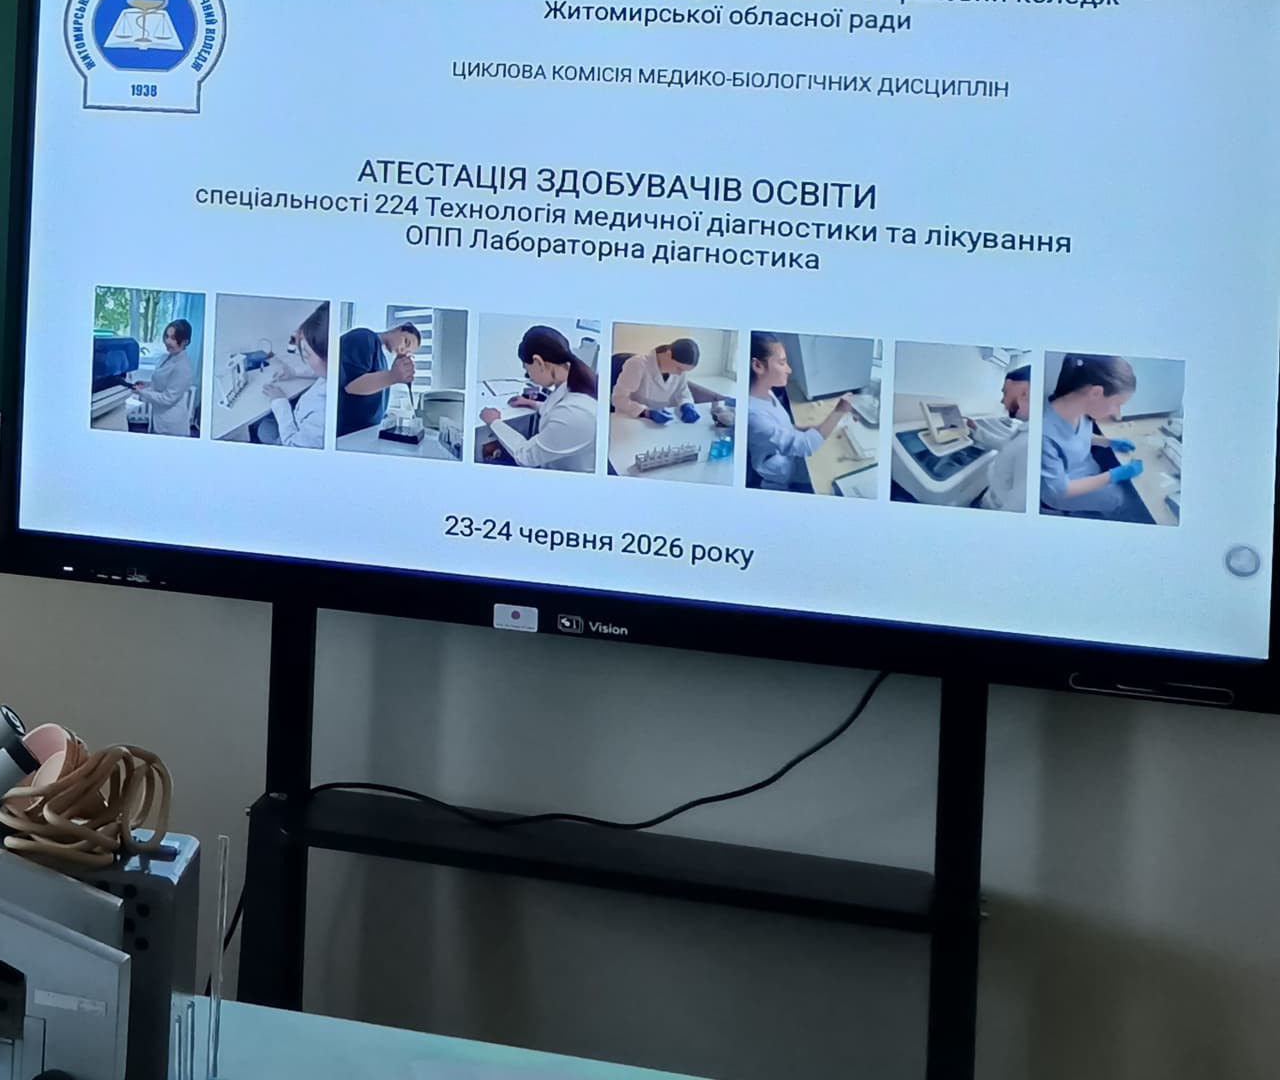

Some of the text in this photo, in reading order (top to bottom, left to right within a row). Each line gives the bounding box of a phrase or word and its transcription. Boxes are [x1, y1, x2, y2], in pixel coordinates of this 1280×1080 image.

[544, 1, 910, 33] Житомирської обласної ради
[191, 28, 217, 73] КОЛЕДЖ
[131, 84, 158, 97] 1938
[453, 62, 1008, 98] ЦИКЛОВА КОМІСІЯ МЕДИКО-БІОЛОГІЧНИХ ДИСЦИПЛІН
[358, 160, 876, 210] АТЕСТАЦІЯ ЗДОБУВАЧІВ ОСВІТИ
[196, 187, 1071, 254] спеціальності 224 Технологія медичної діагностики та лікування
[407, 225, 820, 270] ОПП Лабораторна діагностика
[445, 516, 754, 570] 23-24 червня 2026 року
[589, 621, 629, 636] Vision
